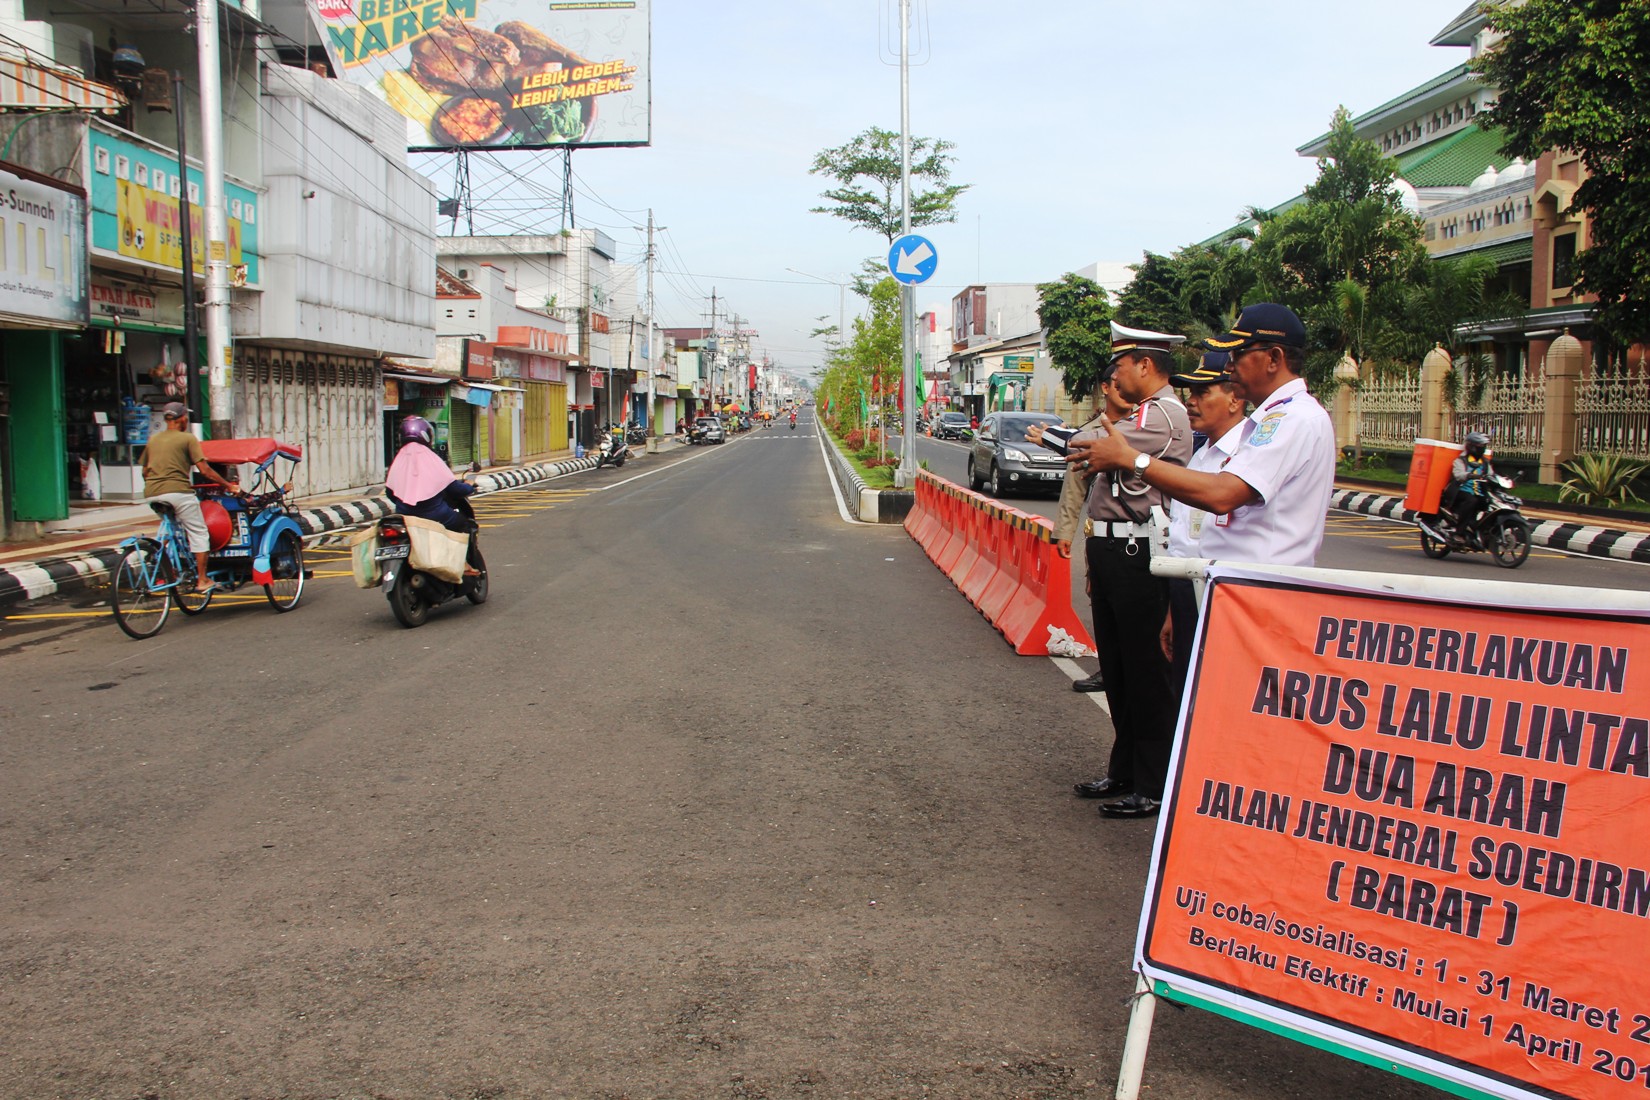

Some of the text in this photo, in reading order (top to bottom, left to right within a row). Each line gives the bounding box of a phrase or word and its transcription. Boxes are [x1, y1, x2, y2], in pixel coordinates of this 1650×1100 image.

[327, 0, 477, 63] MAREM
[360, 0, 436, 21] BEB
[512, 77, 633, 109] LEBIH MAREM...
[522, 60, 637, 90] LEBIH GEDEE...
[145, 198, 202, 239] MEWH
[18, 283, 54, 299] Purbalingga
[126, 290, 153, 309] JAYA
[1314, 616, 1628, 694] PEMBERLAKUAN
[1250, 665, 1370, 731] ARUS
[1376, 683, 1493, 750] LALU
[1322, 742, 1568, 839] DUA ARAH
[1195, 778, 1291, 834] JALAN
[1293, 799, 1459, 874] JENDERAL
[1349, 865, 1492, 939] BARAT
[1175, 886, 1207, 916] Uji
[1211, 901, 1408, 971] coba/sosialisasi
[1434, 958, 1448, 982] 1
[1476, 969, 1511, 1001] 31
[1522, 982, 1620, 1034] Maret
[1188, 926, 1277, 970] Berlaku
[1284, 954, 1369, 998] Efektif
[1391, 987, 1469, 1029] Mulai
[1479, 1014, 1493, 1036] 1
[1504, 1023, 1582, 1065] April
